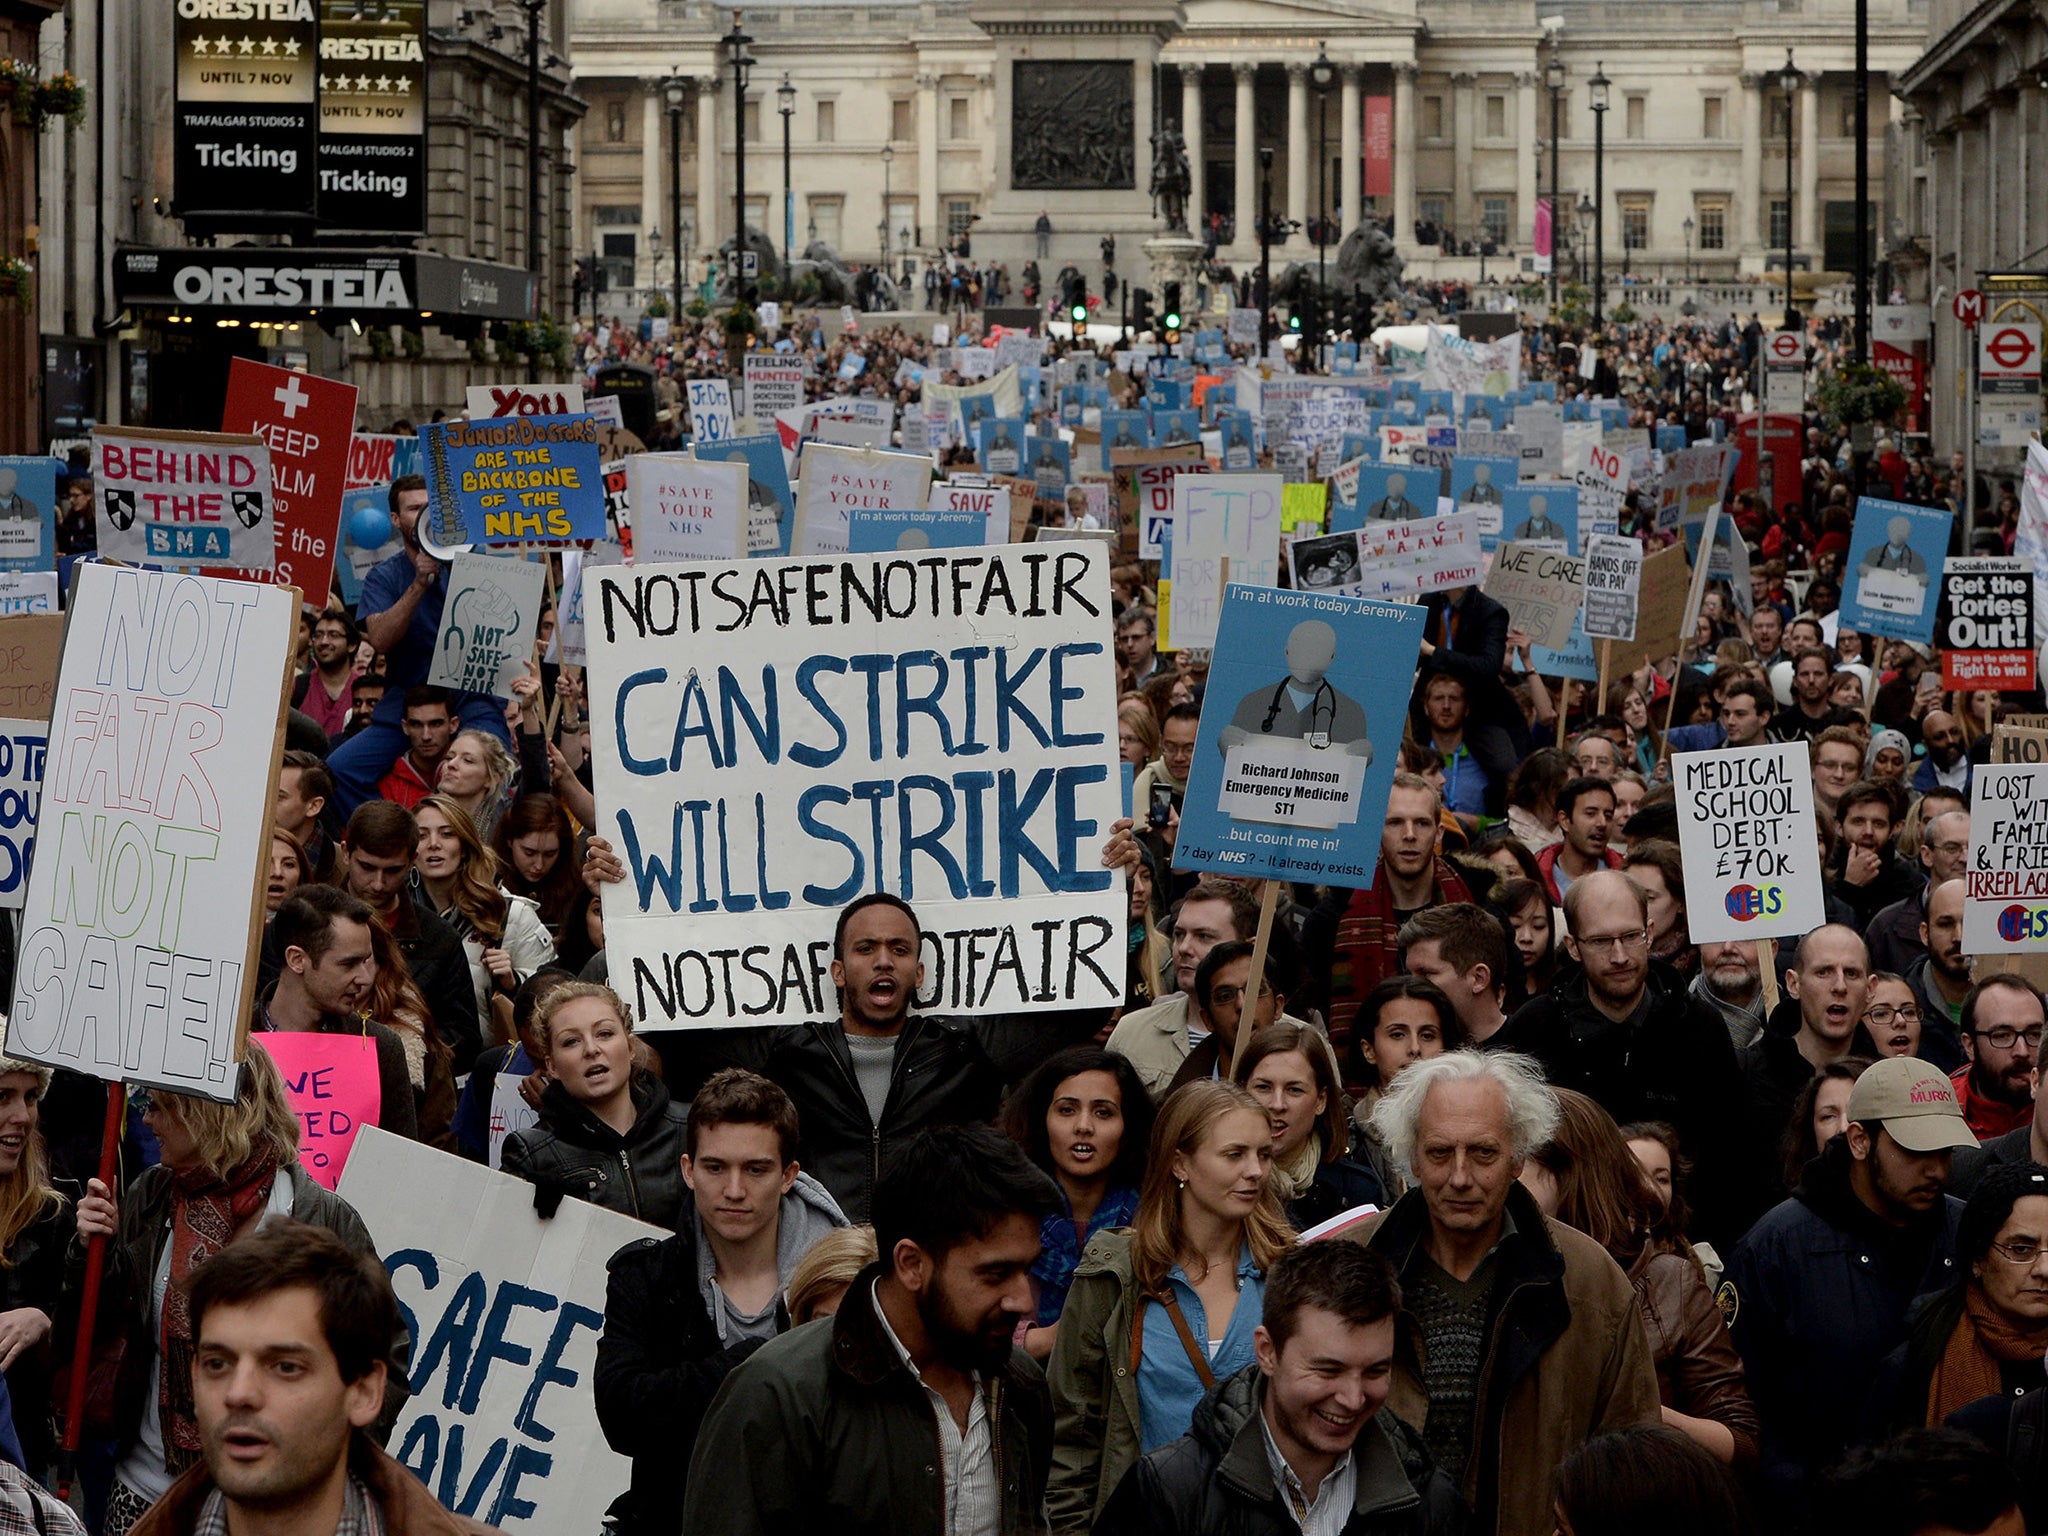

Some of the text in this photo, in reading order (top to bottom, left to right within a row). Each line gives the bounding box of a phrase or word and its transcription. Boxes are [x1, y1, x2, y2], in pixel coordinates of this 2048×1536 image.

[177, 0, 315, 22] ORESTEIA
[319, 37, 424, 62] RESTEIA
[201, 72, 293, 85] UNTIL 7 NOV
[184, 115, 304, 128] TRAFALGAR STUDIOS 2
[323, 107, 404, 118] UNTIL 7 NOV
[195, 143, 297, 174] Ticking
[364, 146, 414, 157] STUDIOS 2
[320, 170, 407, 198] Ticking
[173, 265, 411, 308] ORESTEIA
[1958, 295, 1982, 318] M
[747, 357, 802, 368] FEELING
[1877, 358, 1913, 372] SALE
[747, 371, 802, 381] HUNTED
[753, 383, 795, 391] PROTECT
[490, 387, 568, 418] YOU
[252, 420, 319, 458] KEEP
[102, 444, 256, 487] BEHIND
[475, 448, 551, 469] ARE THE
[1590, 445, 1619, 479] NO
[270, 464, 315, 499] ALM
[462, 467, 581, 493] BACKBONE
[830, 473, 894, 492] #SAVE
[480, 492, 560, 508] OF THE
[658, 484, 713, 501] #SAVE
[829, 490, 890, 510] YOUR
[143, 493, 223, 522] THE
[272, 498, 289, 513] ND
[659, 502, 713, 519] YOUR
[949, 493, 995, 517] SAVE
[485, 508, 572, 538] NHS
[668, 521, 703, 535] NHS
[854, 511, 871, 521] I'm
[872, 513, 885, 522] at
[886, 513, 908, 522] work
[910, 512, 936, 523] today
[1186, 487, 1275, 552] FTP
[152, 530, 222, 554] BMA
[292, 528, 326, 558] the
[1175, 558, 1217, 586] FOR
[1434, 567, 1477, 584] FAMILY!
[1500, 545, 1586, 585] WE CARE
[1589, 555, 1638, 576] HANDS OFF
[1952, 561, 2022, 571] Socialist Worker
[1587, 572, 1628, 590] OUR PAY
[1948, 576, 2027, 595] Get the
[1231, 586, 1417, 623] I'm at work today Jeremy...
[1948, 594, 2027, 617] Tories
[96, 571, 260, 708] NOT
[472, 624, 504, 646] NOT
[1948, 616, 2027, 648] Out!
[467, 646, 502, 667] SAFE
[1952, 654, 1971, 664] Step
[1984, 654, 1997, 663] the
[1999, 654, 2026, 663] strikes
[463, 665, 499, 682] NOT
[1952, 664, 2027, 678] Fight to win
[0, 683, 53, 706] CTOR
[461, 677, 495, 695] FAIR
[55, 688, 224, 832] FAIR
[2003, 737, 2048, 763] HO
[1241, 763, 1340, 784] Richard Johnson
[1687, 755, 1793, 791] MEDICAL
[1225, 780, 1349, 803] Emergency Medicine
[1982, 775, 2035, 800] LOST
[1274, 802, 1295, 816] ST1
[1694, 786, 1800, 822] SCHOOL
[2013, 799, 2048, 821] WIT
[1218, 828, 1340, 851] ...but count me in!
[1714, 819, 1793, 849] DEBT:
[1992, 821, 2048, 846] FAMI
[1182, 845, 1190, 856] 7
[1192, 846, 1214, 863] day
[1217, 850, 1247, 864] NHS
[1268, 855, 1276, 867] It
[1279, 856, 1326, 874] already
[1328, 862, 1367, 877] exists.
[1977, 845, 2048, 870] & FRIE
[51, 812, 220, 954] NOT
[1726, 885, 1782, 917] NHS
[2000, 911, 2048, 939] NHS
[15, 927, 240, 1084] SAFE!
[1910, 1090, 1953, 1103] MURKY
[382, 1247, 605, 1442] SAFE
[397, 1414, 555, 1528] AVE
